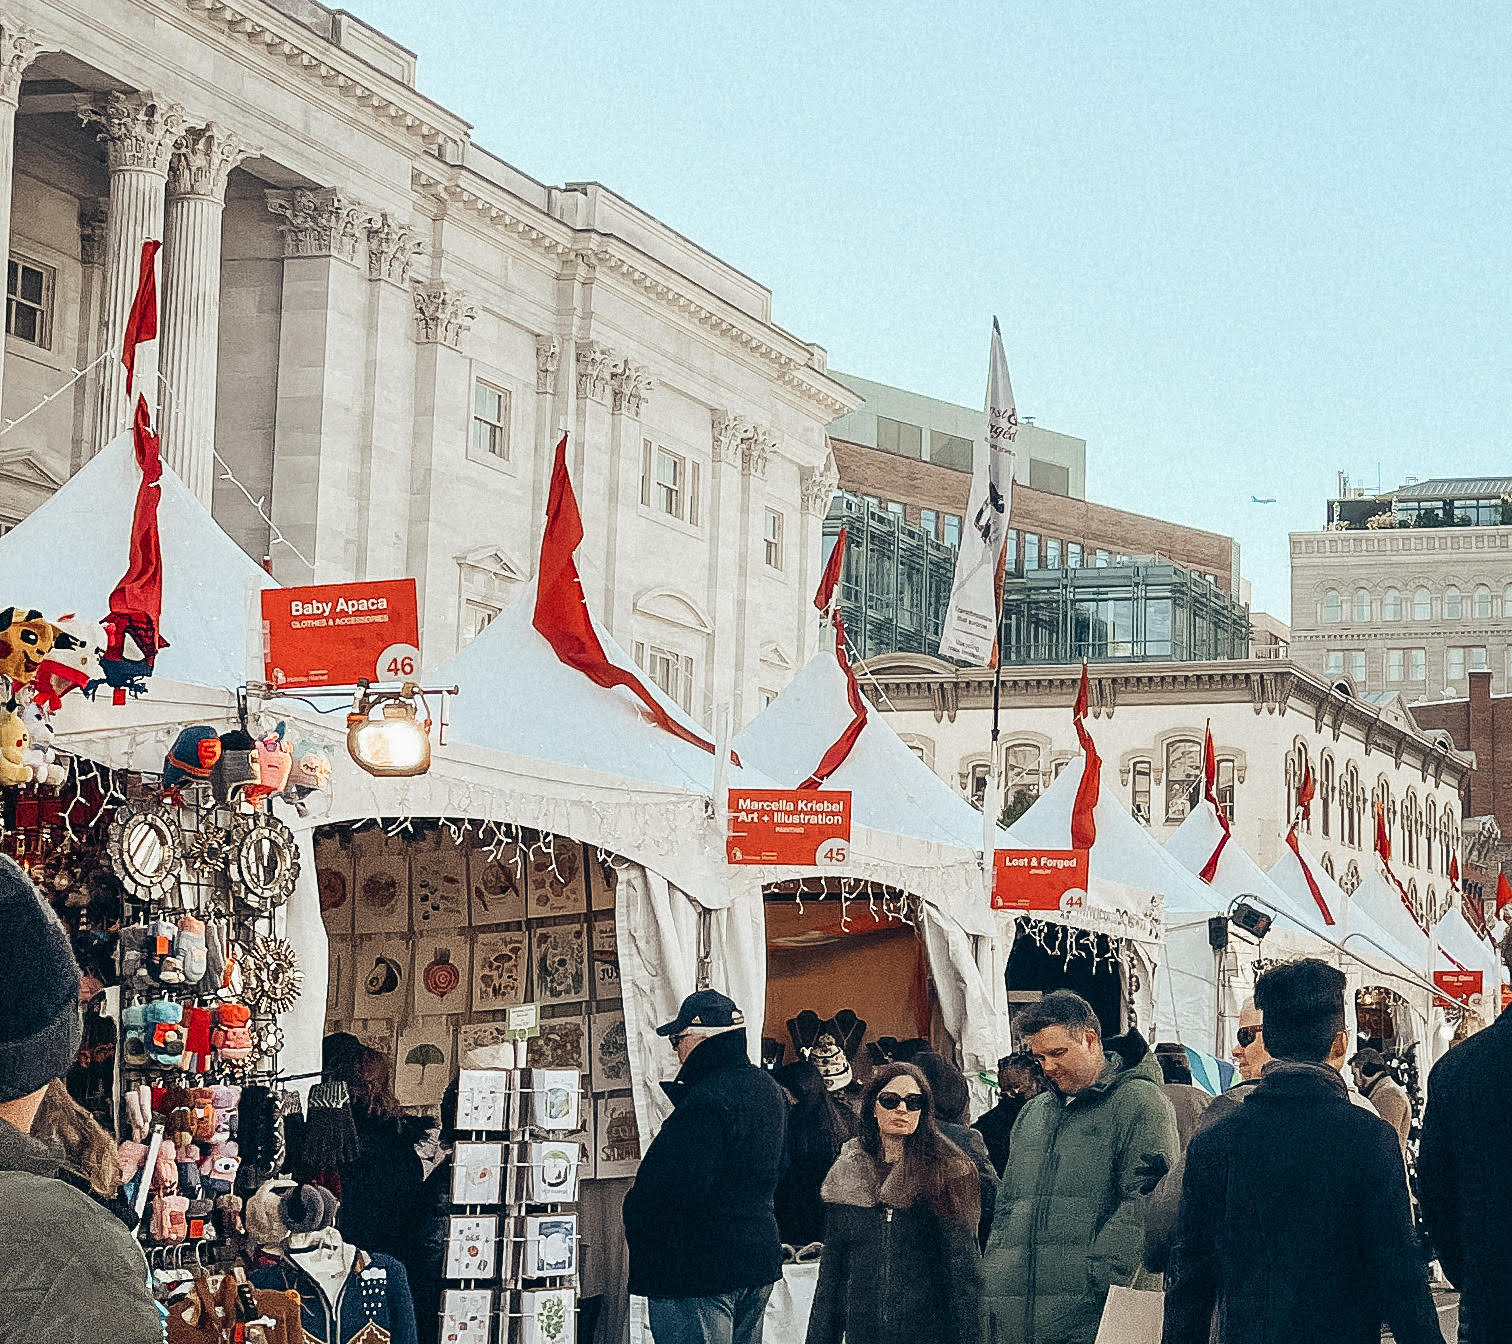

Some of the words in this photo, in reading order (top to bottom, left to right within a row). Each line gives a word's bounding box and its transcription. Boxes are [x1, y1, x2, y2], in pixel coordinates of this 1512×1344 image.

[291, 600, 333, 616] Baby
[336, 597, 388, 615] Apaca
[291, 618, 327, 629] CLOTHES
[328, 618, 334, 626] &
[335, 615, 389, 625] ACCESSORIES
[386, 656, 414, 676] 46
[738, 798, 794, 812] Marcella
[797, 800, 844, 812] Kriebel
[737, 811, 759, 823] Art
[762, 814, 770, 822] +
[773, 811, 843, 825] Illustration
[824, 847, 846, 862] 45
[1005, 856, 1028, 867] Lost
[1030, 857, 1038, 867] &
[1040, 857, 1077, 869] Forged
[1065, 896, 1083, 907] 44
